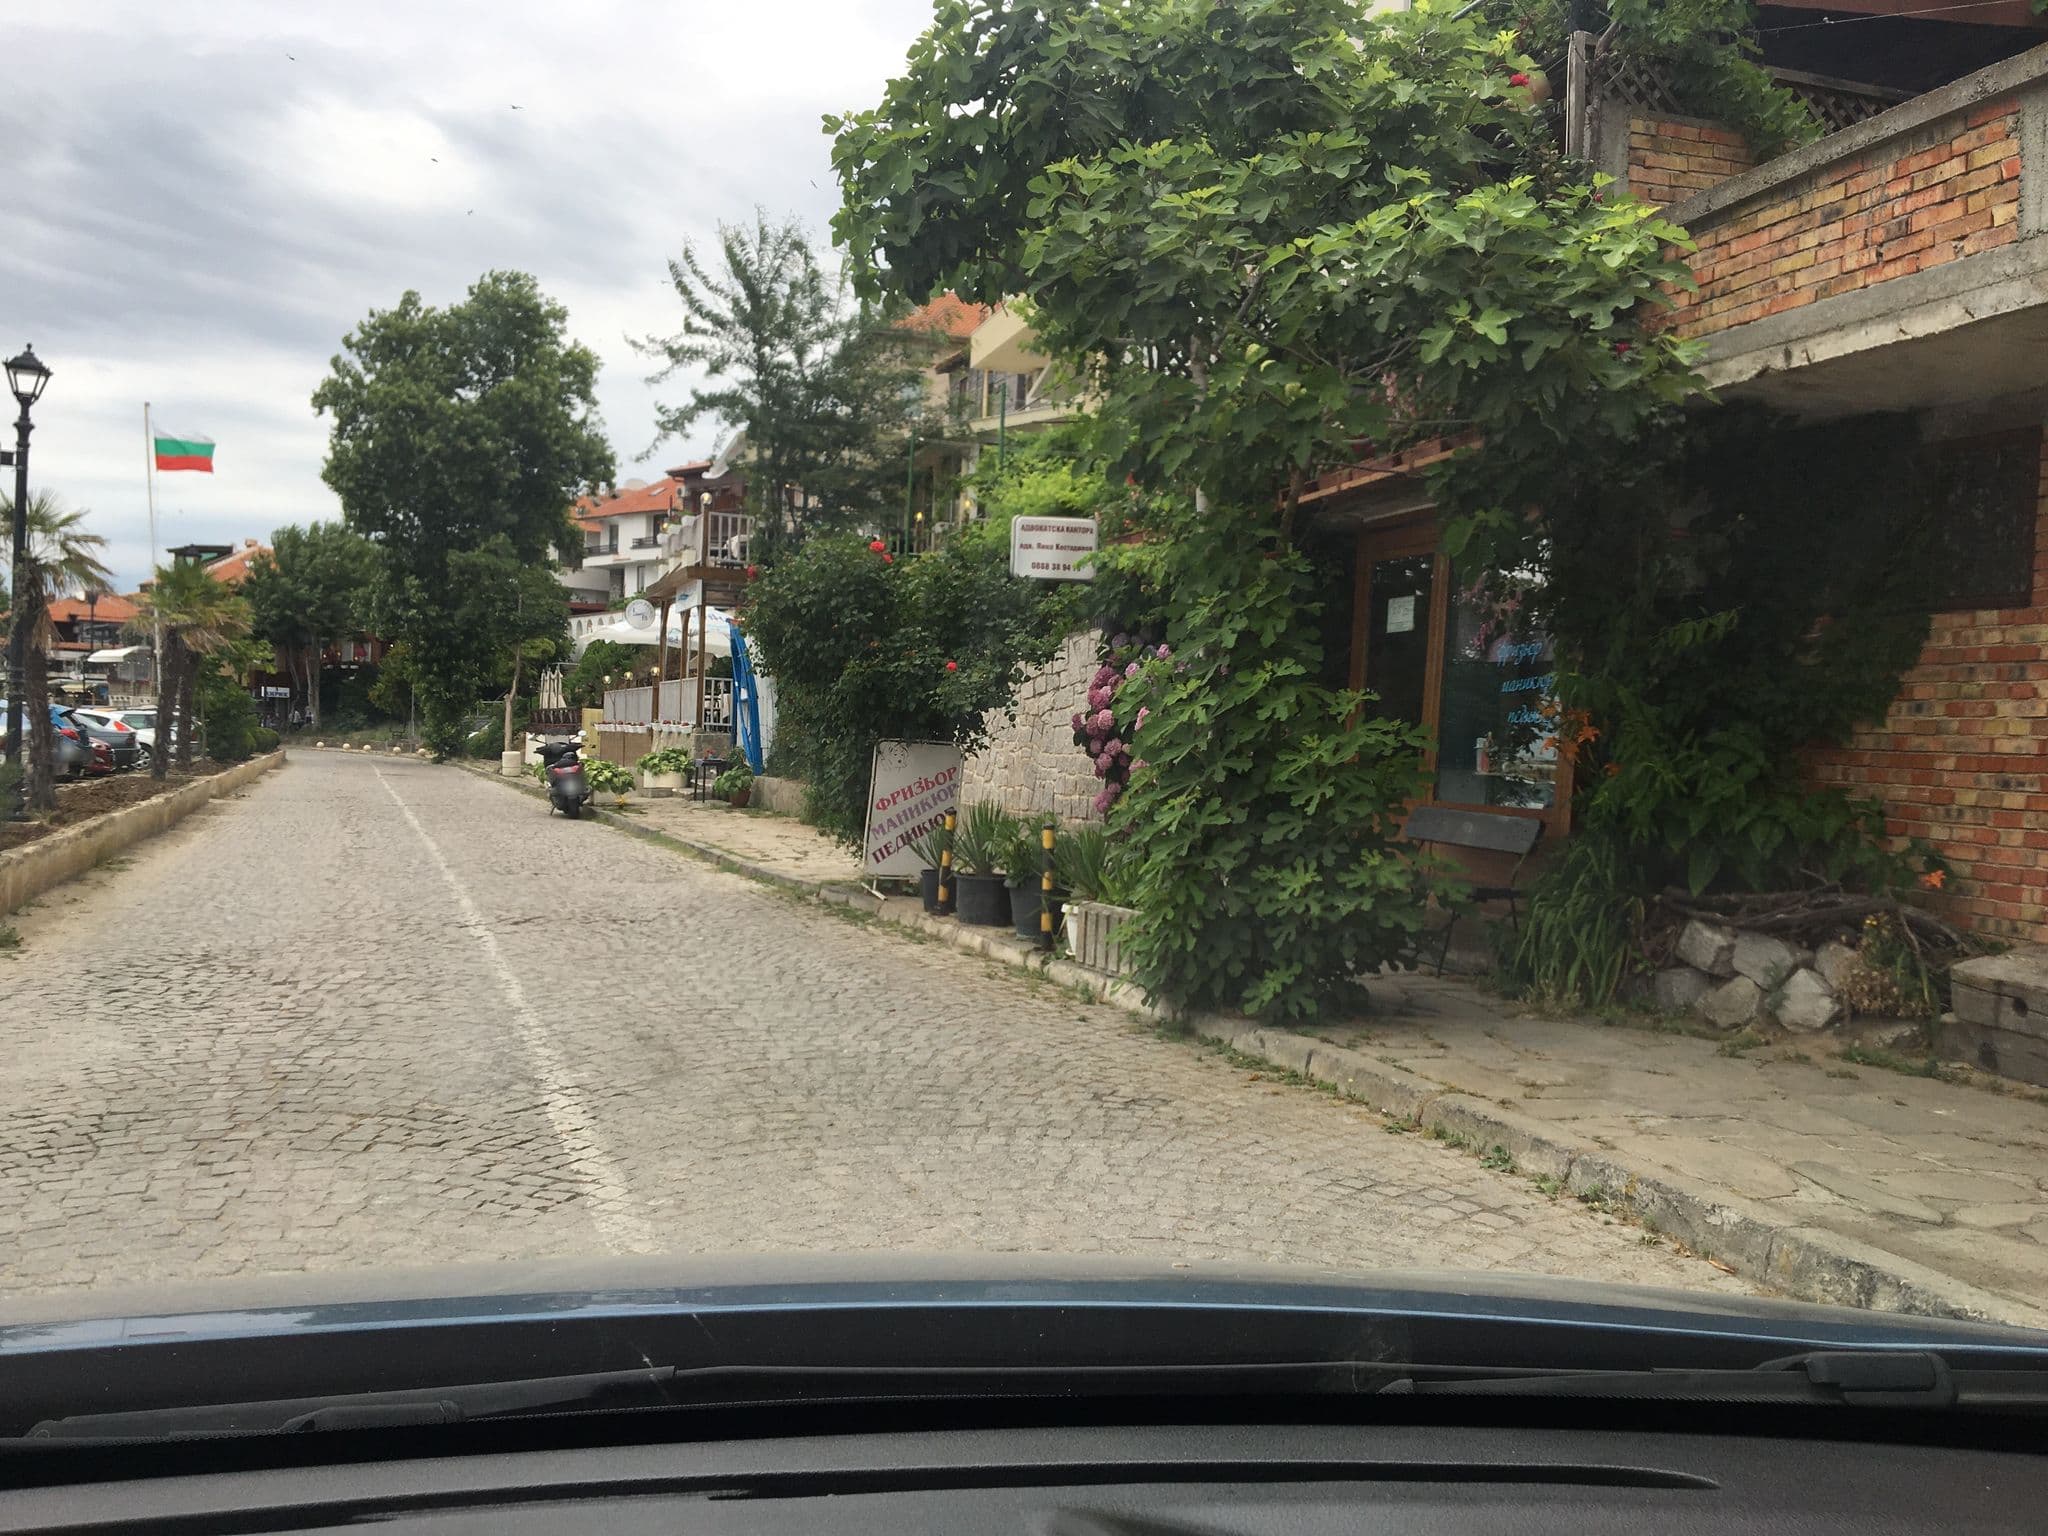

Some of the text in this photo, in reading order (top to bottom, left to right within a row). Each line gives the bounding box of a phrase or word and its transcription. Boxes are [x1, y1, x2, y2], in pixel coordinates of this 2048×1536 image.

[870, 783, 959, 840] МАНИКЮР
[876, 766, 957, 811] ФРИЗЬОР
[872, 806, 955, 864] ПЕДИКЮ
